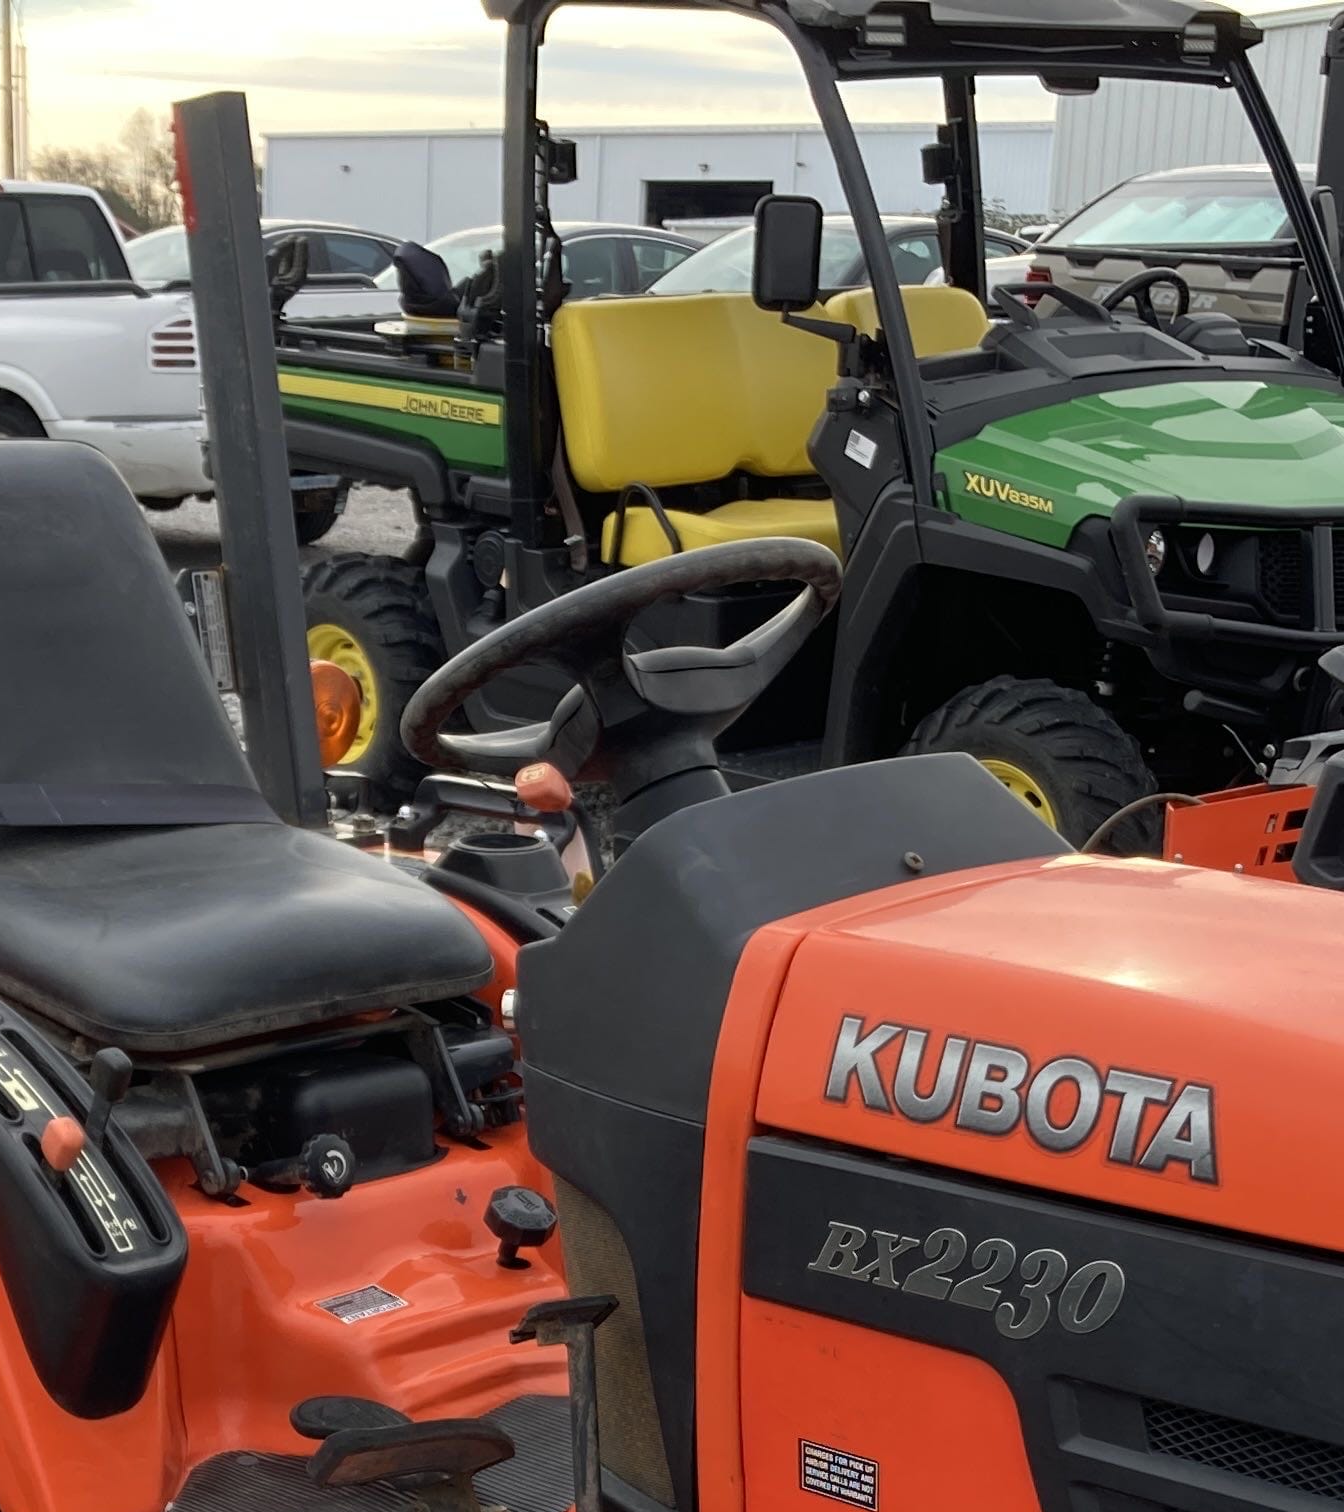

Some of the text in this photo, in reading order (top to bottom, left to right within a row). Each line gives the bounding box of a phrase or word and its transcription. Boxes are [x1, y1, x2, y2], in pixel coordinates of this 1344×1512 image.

[400, 395, 484, 421] JOHN DEERE
[964, 471, 1054, 514] XUV835M
[824, 1014, 1219, 1185] KUBOTA
[808, 1221, 1126, 1341] BX2230
